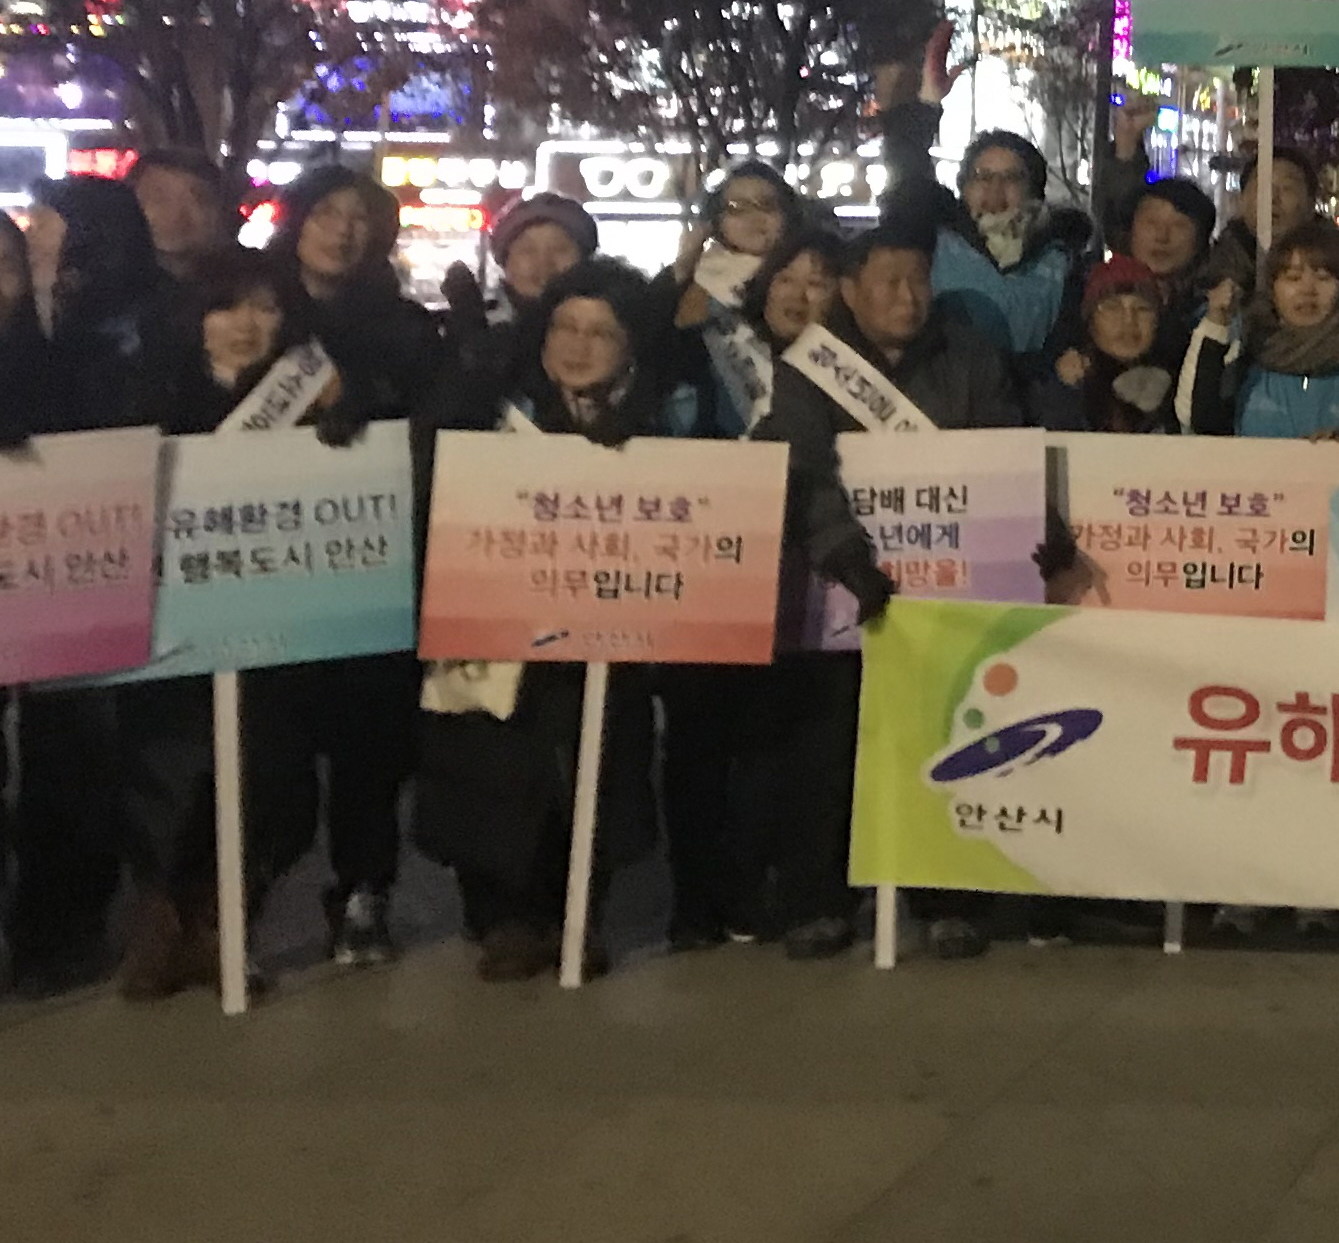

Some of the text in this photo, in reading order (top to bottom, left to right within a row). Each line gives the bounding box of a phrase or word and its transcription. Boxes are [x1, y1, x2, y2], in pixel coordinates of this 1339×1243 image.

[168, 492, 396, 540] 유해환경 OUT!
[853, 484, 968, 516] 담배 대신
[467, 530, 560, 563] 가정과
[651, 531, 743, 565] 국가의
[878, 521, 960, 551] 년에게
[1073, 524, 1152, 552] 가정과
[1234, 526, 1316, 557] 국가의
[65, 545, 128, 585] 안산
[180, 532, 389, 585] 행복도시 안산
[530, 569, 685, 602] 의무입니다
[1126, 561, 1265, 592] 의무입니다
[955, 802, 1064, 836] 안산시
